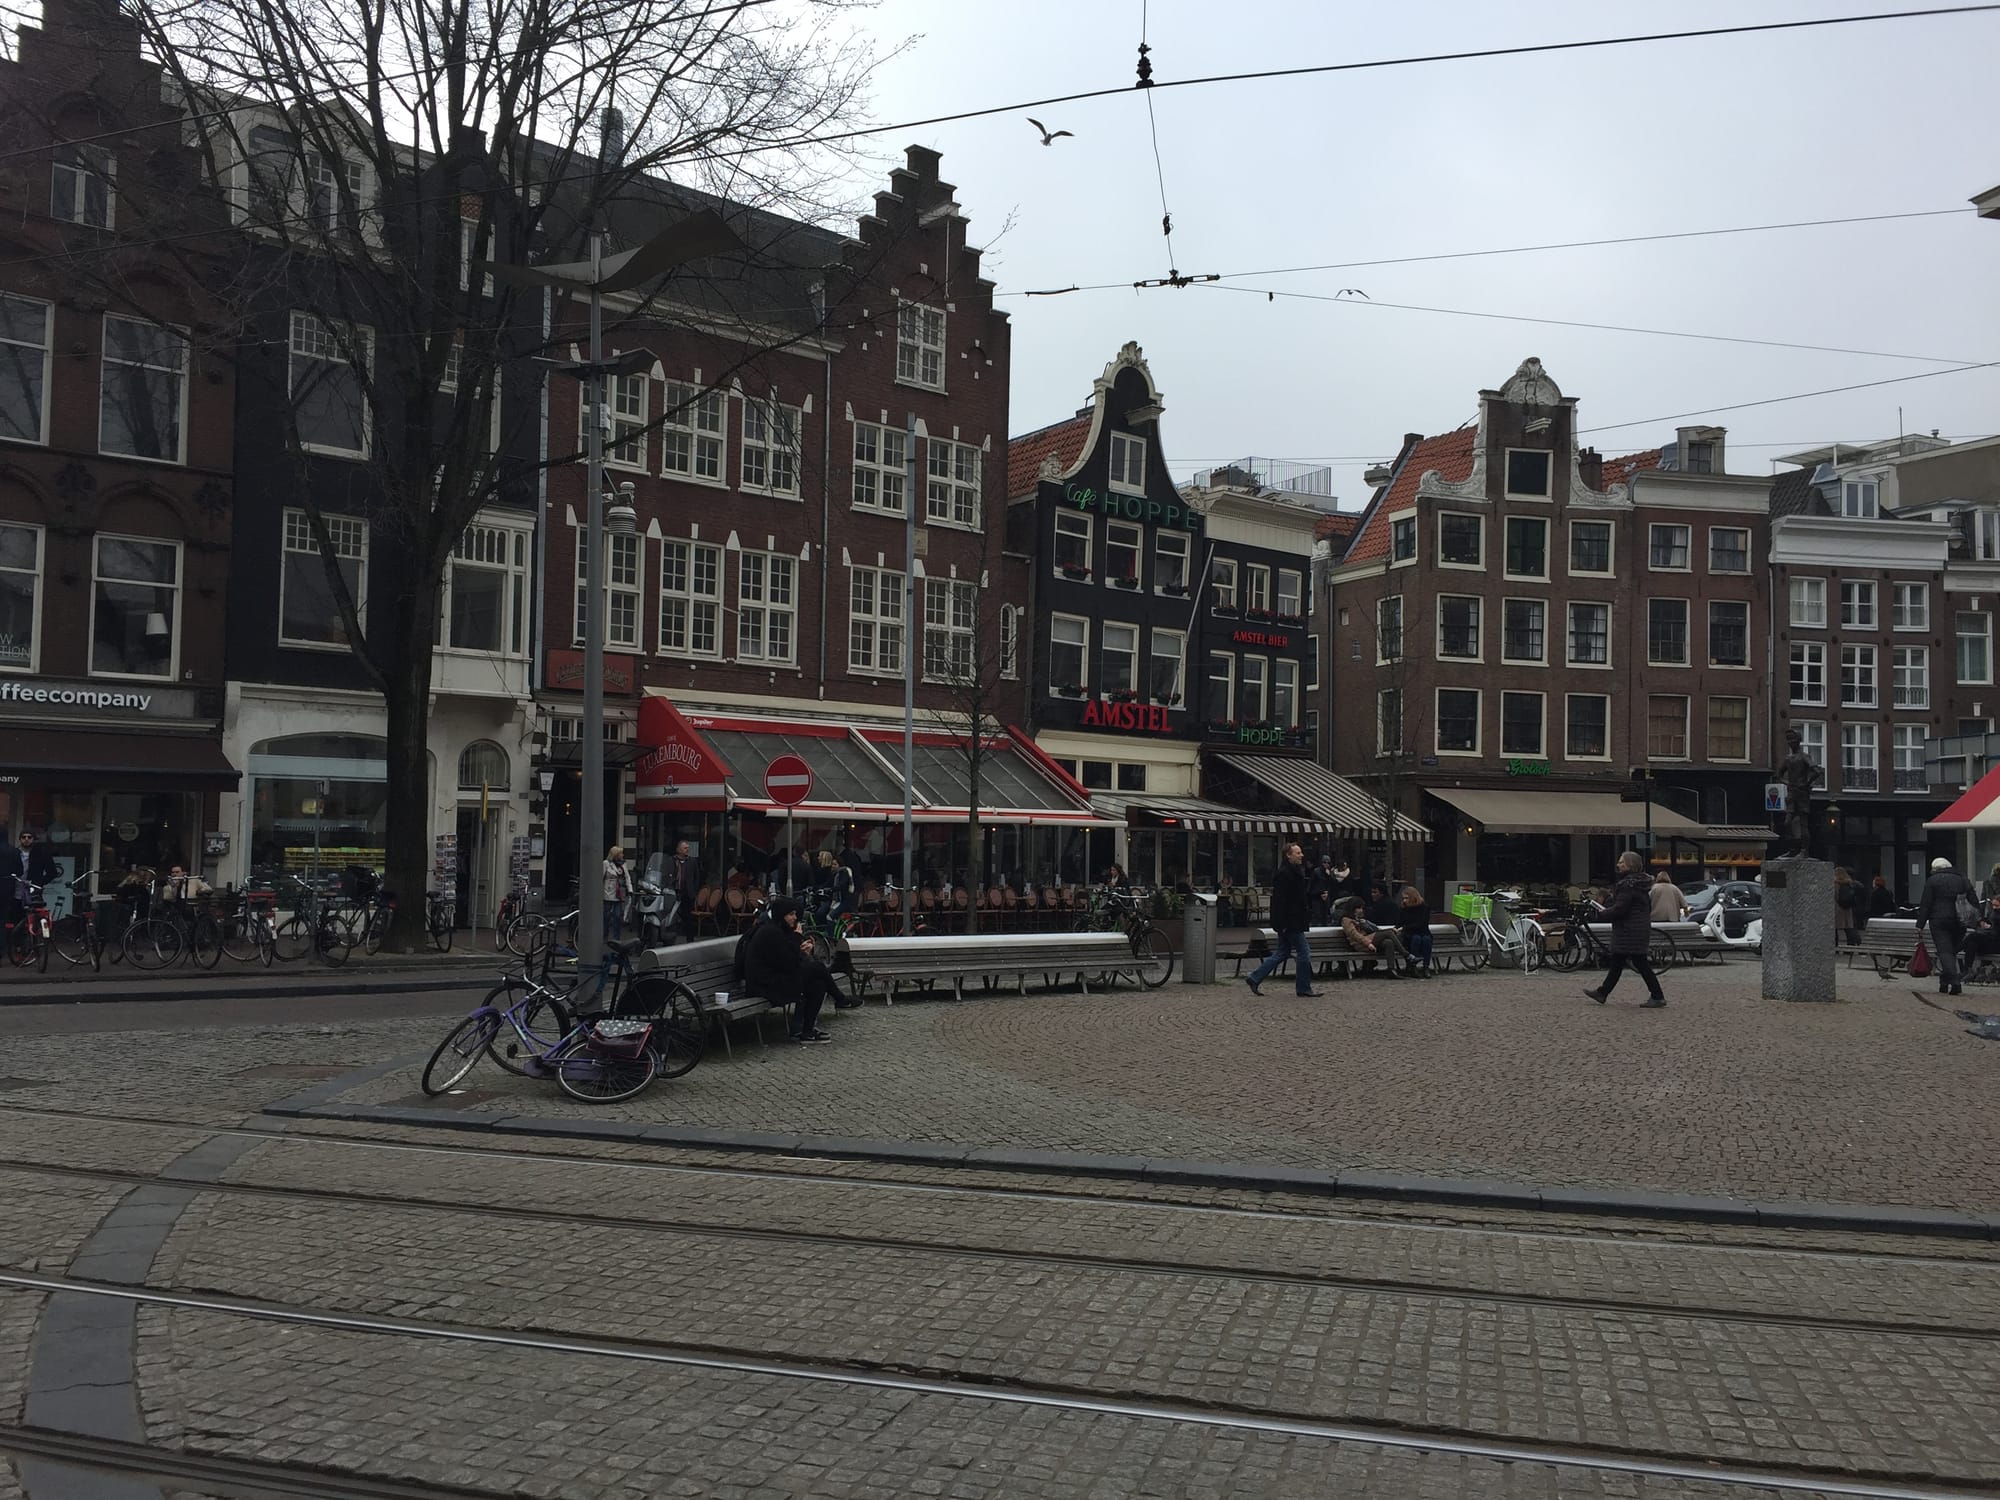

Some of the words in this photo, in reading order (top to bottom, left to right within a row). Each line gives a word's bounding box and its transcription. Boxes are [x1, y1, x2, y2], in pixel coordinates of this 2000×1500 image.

[1104, 492, 1198, 529] HOPPE
[1233, 630, 1266, 645] AMSTEL
[1268, 634, 1288, 648] BIER
[0, 682, 152, 710] ffeecompany
[1081, 698, 1173, 732] AMSTEL
[1240, 727, 1286, 746] HOPPE
[642, 744, 702, 776] LUXEMBOURG
[0, 776, 20, 784] any
